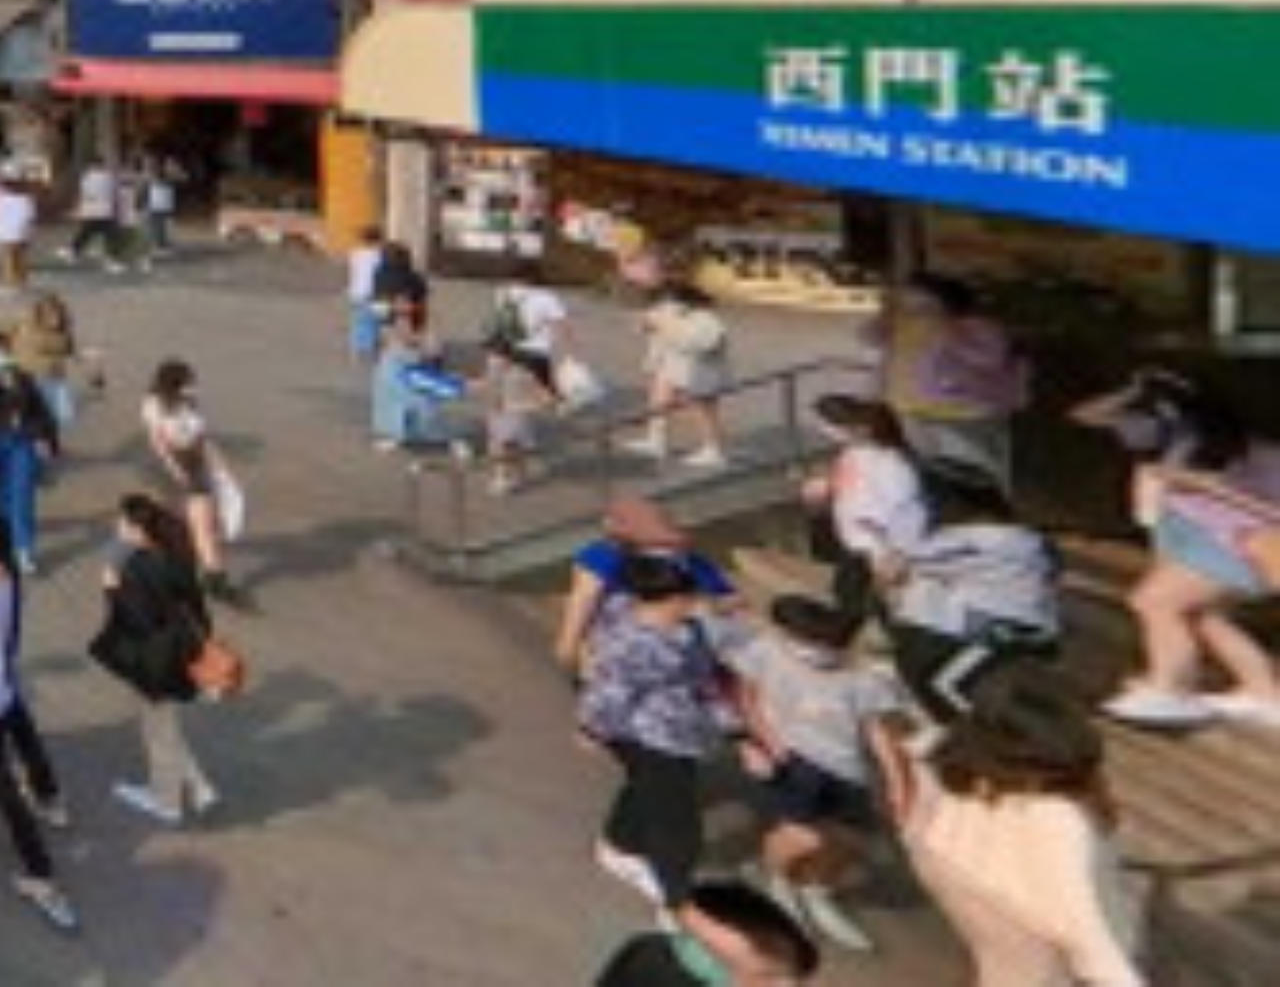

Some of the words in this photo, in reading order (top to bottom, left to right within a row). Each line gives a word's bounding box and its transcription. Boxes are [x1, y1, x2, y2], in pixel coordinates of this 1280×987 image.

[766, 45, 1110, 135] 西門站
[758, 118, 892, 160] XIMEN
[900, 131, 1130, 190] STATION
